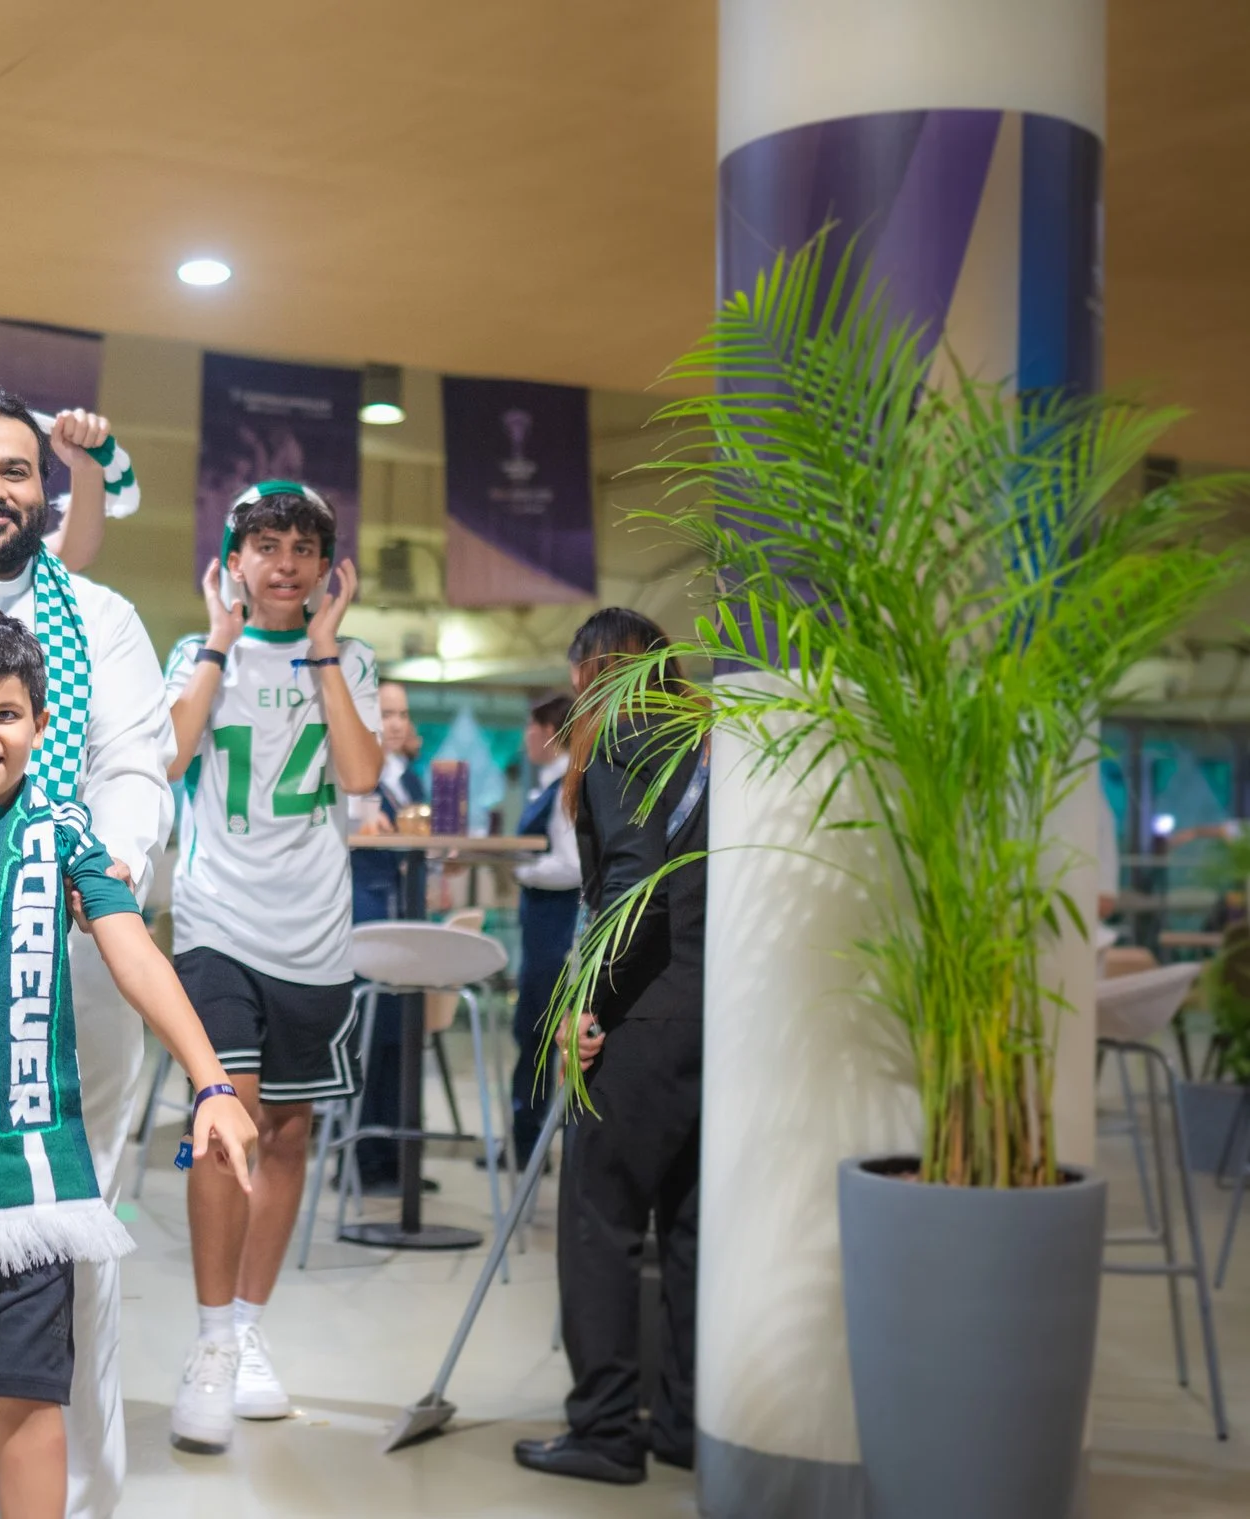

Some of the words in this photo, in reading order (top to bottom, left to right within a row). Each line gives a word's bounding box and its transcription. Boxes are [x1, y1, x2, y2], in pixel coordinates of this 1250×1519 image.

[258, 688, 305, 708] EID
[213, 723, 337, 834] 14
[8, 820, 58, 1127] FOREVER
